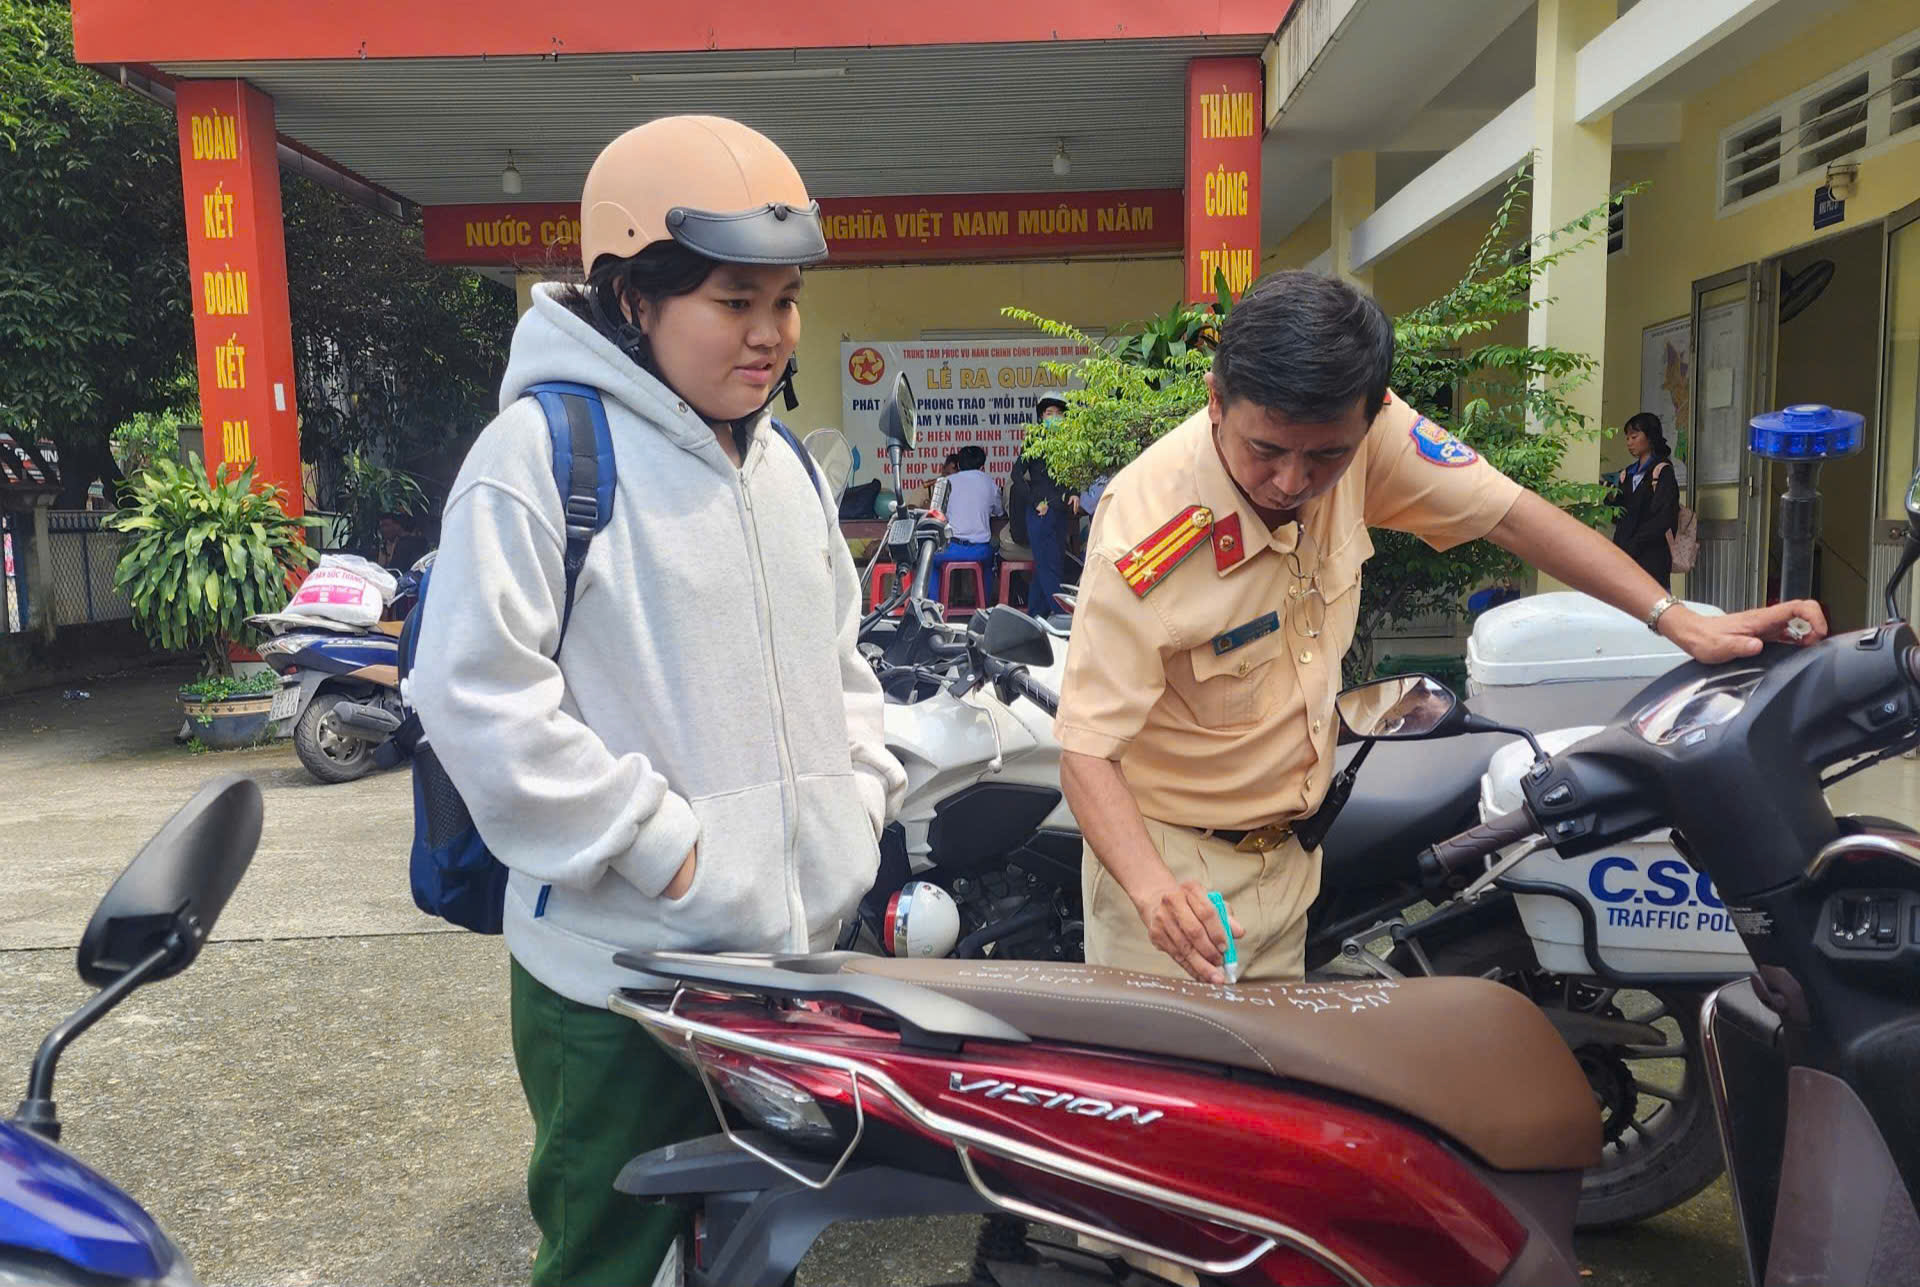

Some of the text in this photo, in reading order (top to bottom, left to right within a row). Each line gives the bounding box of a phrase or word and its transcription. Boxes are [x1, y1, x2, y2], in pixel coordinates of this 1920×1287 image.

[192, 107, 237, 160] ĐOÀN
[1200, 84, 1254, 138] THÀNH
[203, 180, 233, 238] KẾT
[1205, 163, 1249, 216] CÔNG
[466, 214, 531, 248] NƯỚC
[541, 215, 582, 251] CỘN
[895, 208, 943, 243] VIỆT
[953, 210, 1009, 237] NAM
[1018, 204, 1088, 234] MUÔN
[1097, 203, 1153, 232] NĂM
[203, 263, 248, 315] ĐOÀN
[215, 332, 245, 389] KẾT
[927, 360, 952, 390] LỄ
[960, 368, 992, 389] RA
[917, 398, 954, 410] PHONG
[945, 412, 979, 426] NGHĨA
[1606, 907, 1689, 931] TRAFFIC
[1697, 912, 1736, 933] POL
[949, 1071, 1164, 1126] VISION
